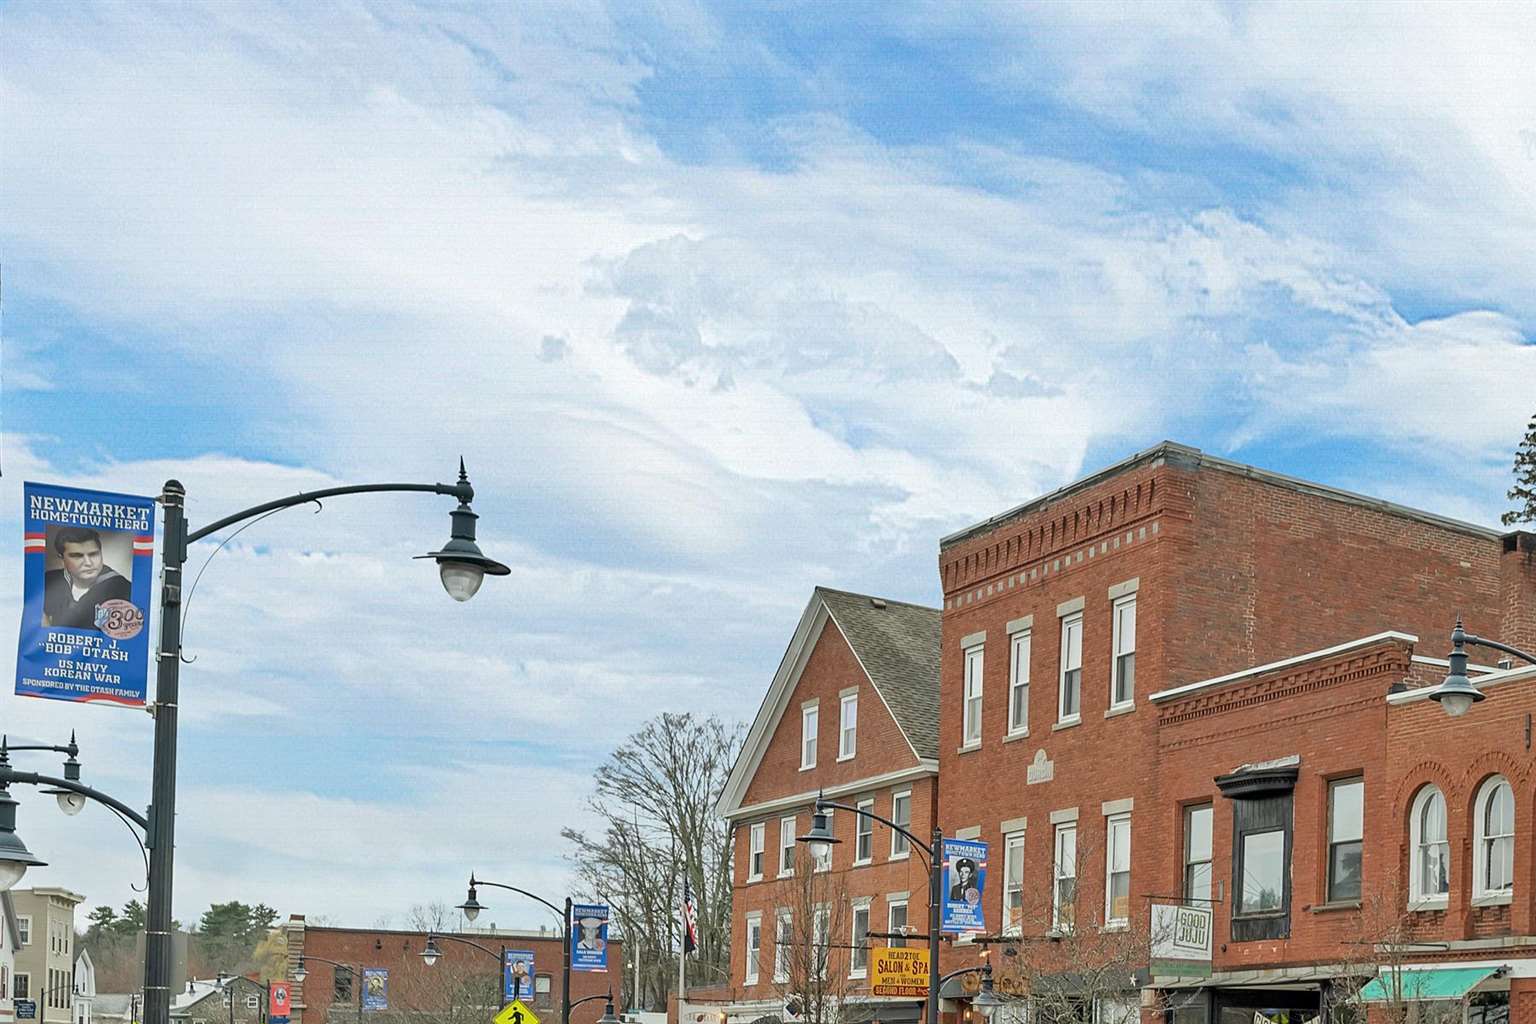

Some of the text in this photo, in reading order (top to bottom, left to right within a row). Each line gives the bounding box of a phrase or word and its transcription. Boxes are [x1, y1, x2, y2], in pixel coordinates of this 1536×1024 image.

[30, 495, 150, 520] NEWMARKET
[31, 508, 149, 531] HOMETOWN HERO
[48, 632, 120, 650] ROBERT J.
[38, 642, 128, 661] "BOB" OTASH
[59, 659, 108, 673] US NAVY
[44, 668, 121, 684] KOREAN WAR
[22, 678, 64, 689] SPONSORED
[65, 682, 75, 690] BY
[75, 683, 90, 692] THE
[114, 688, 141, 698] FAMILY
[945, 844, 986, 855] NEWMARKET
[1180, 912, 1206, 929] GOOD
[1179, 927, 1206, 945] JUJU
[878, 959, 903, 974] SALON
[912, 960, 928, 975] SPA
[900, 977, 924, 985] WOMEN
[875, 986, 916, 995] SECOND FLOOR
